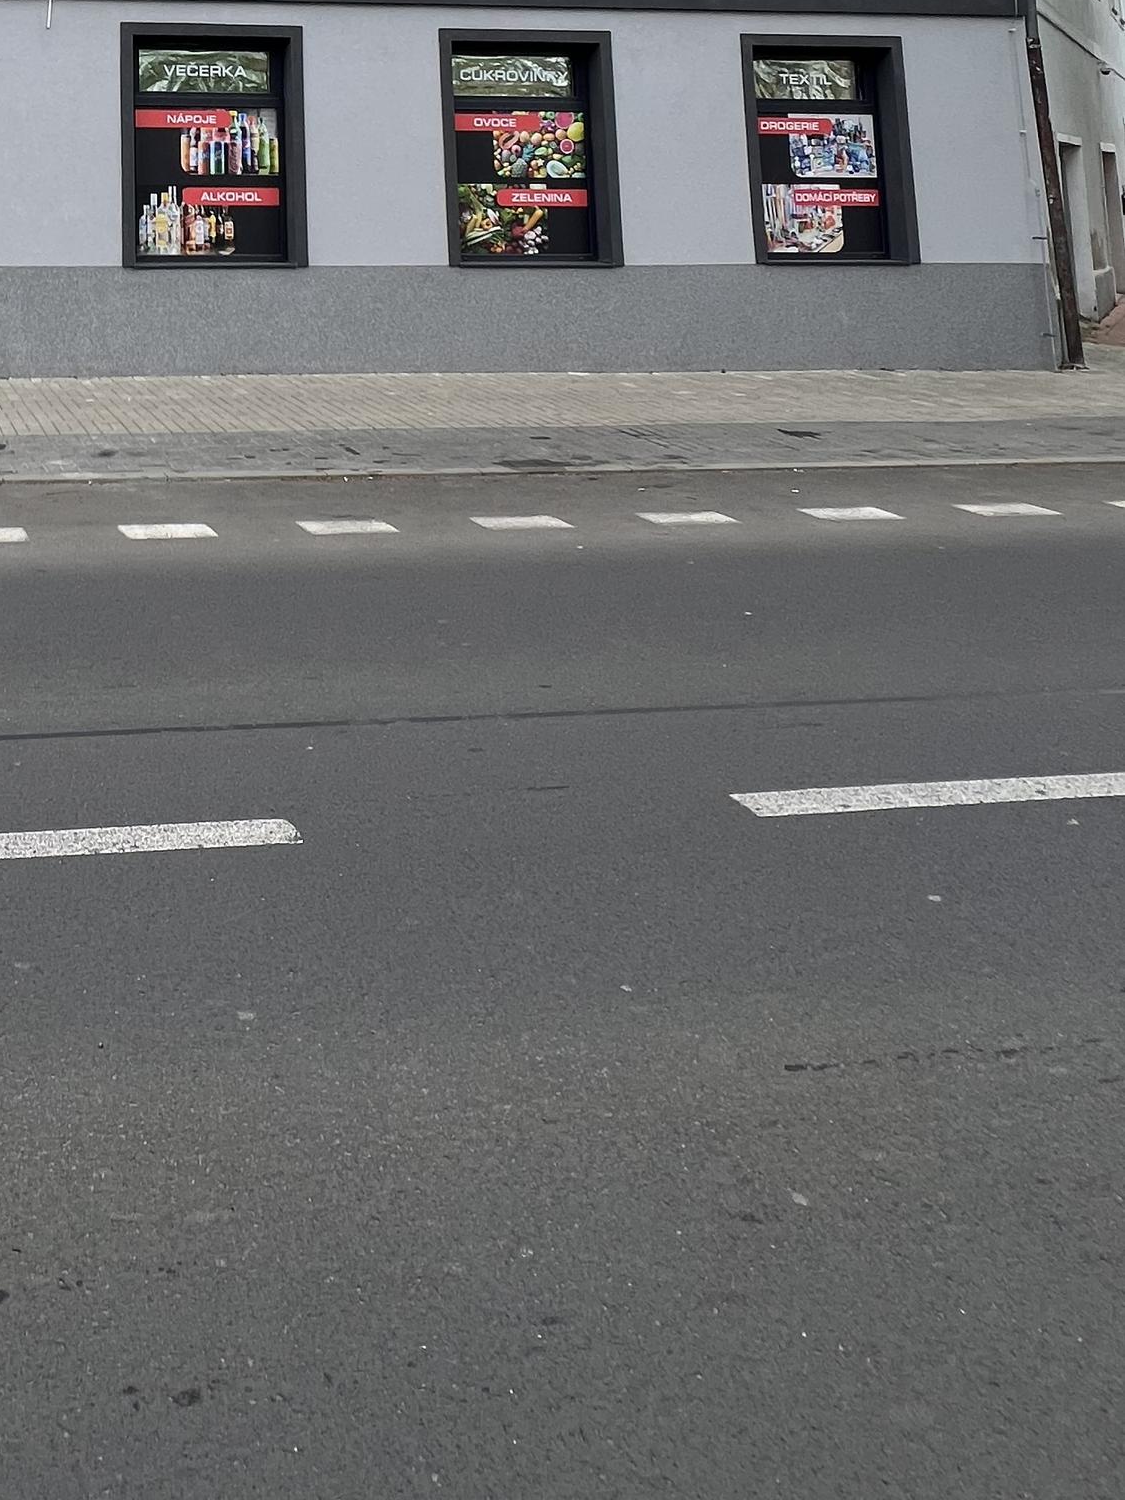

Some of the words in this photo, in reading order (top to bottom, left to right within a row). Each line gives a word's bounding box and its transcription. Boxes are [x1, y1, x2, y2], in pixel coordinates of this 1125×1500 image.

[163, 62, 247, 77] VEČERKA
[166, 112, 217, 124] NÁPOJE
[473, 118, 517, 128] OVOCE
[760, 121, 820, 132] DROGERIE
[201, 190, 262, 202] ALKOHOL
[511, 192, 573, 203] ZELENINA
[795, 189, 832, 203] DOMÁCÍ
[833, 190, 876, 203] POTŘEBY
